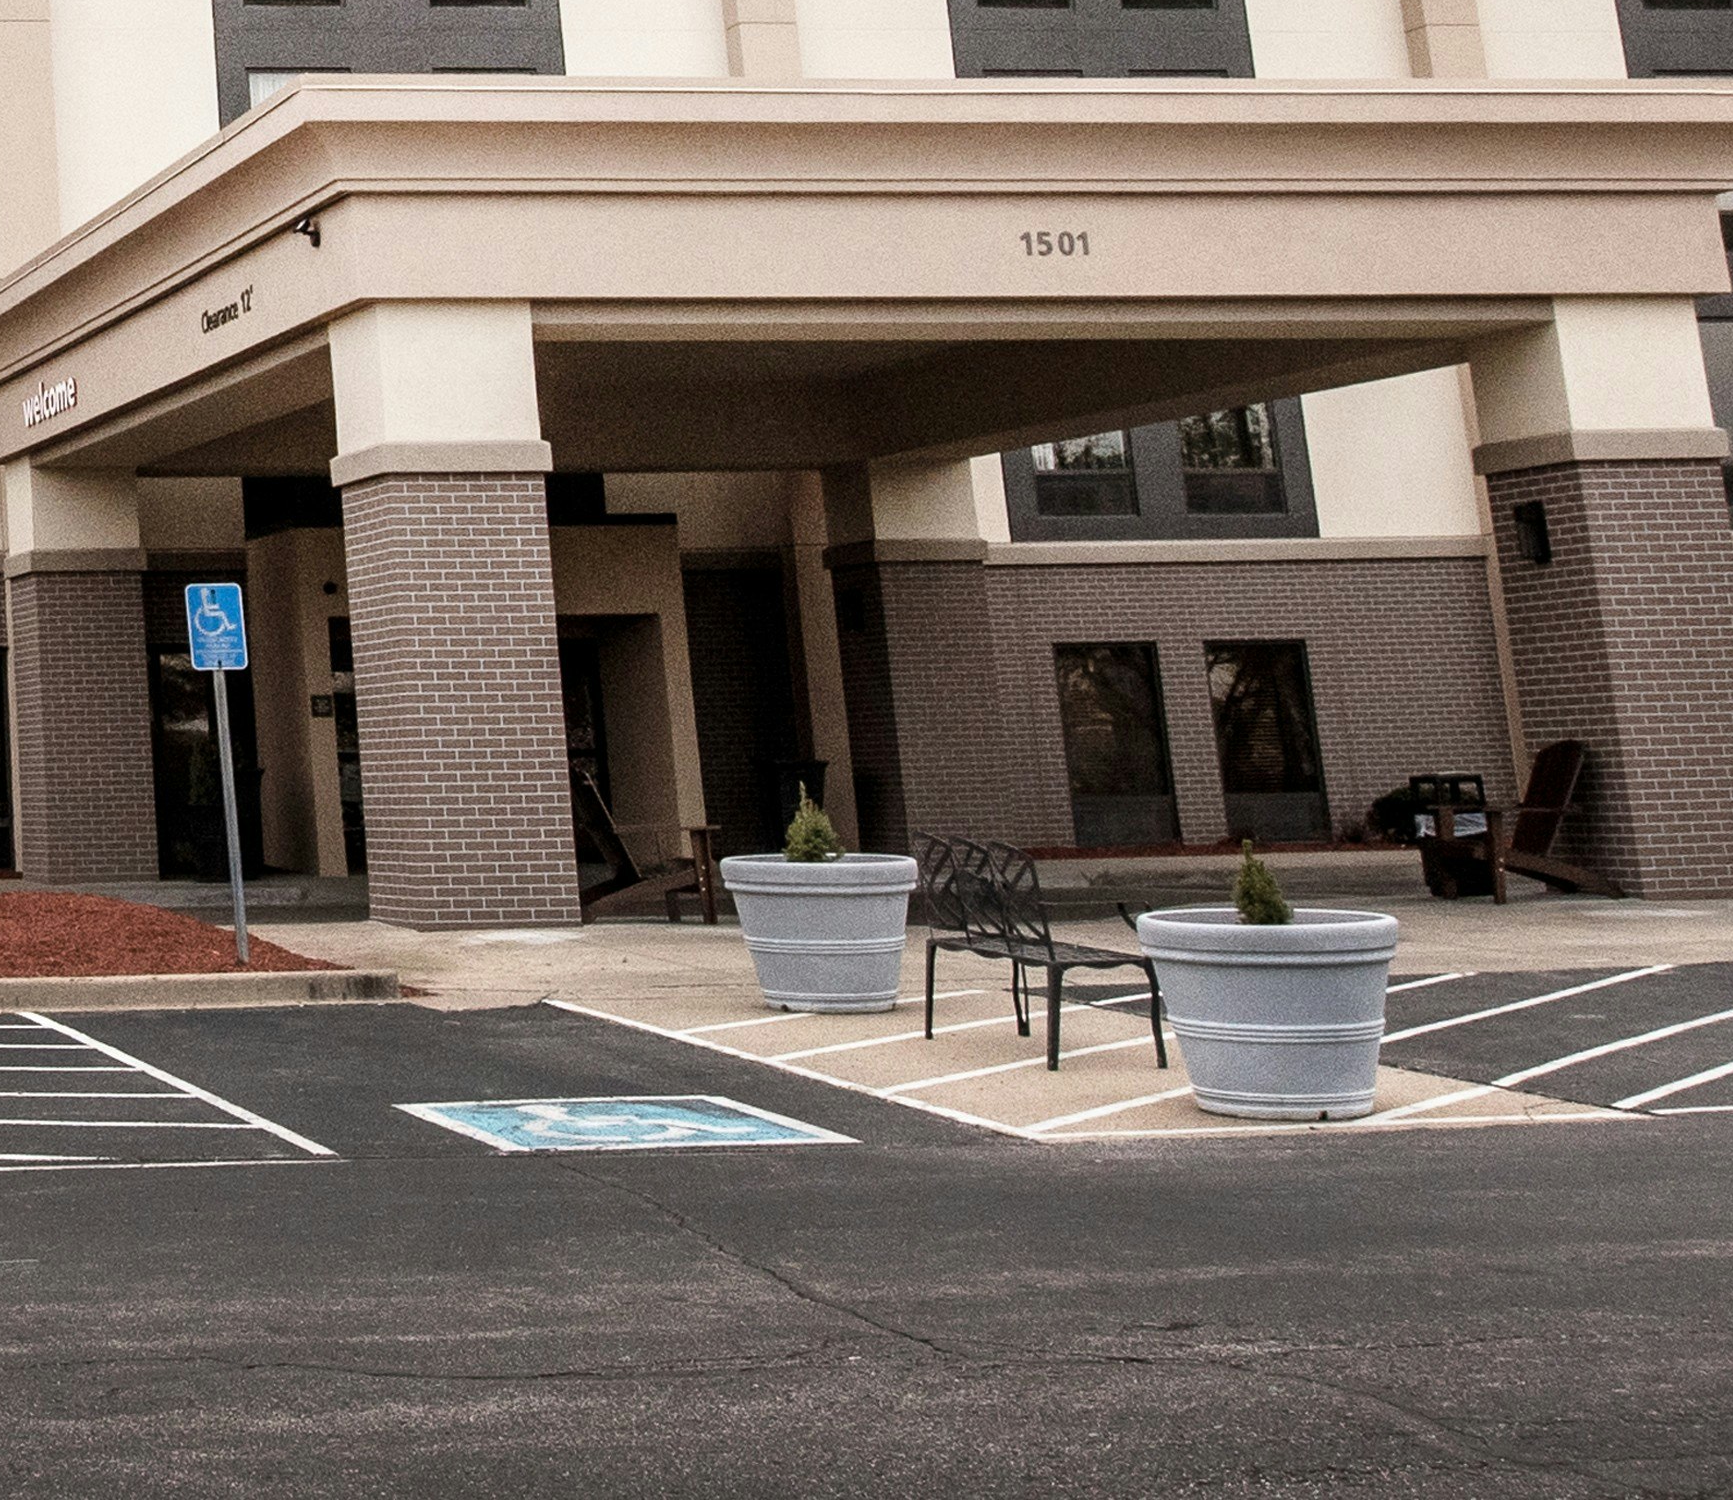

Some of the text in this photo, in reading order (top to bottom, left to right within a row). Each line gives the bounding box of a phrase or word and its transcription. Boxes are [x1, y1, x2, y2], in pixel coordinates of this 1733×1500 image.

[1019, 231, 1090, 256] 1501
[201, 301, 239, 334] Clearance
[22, 376, 77, 428] welcome
